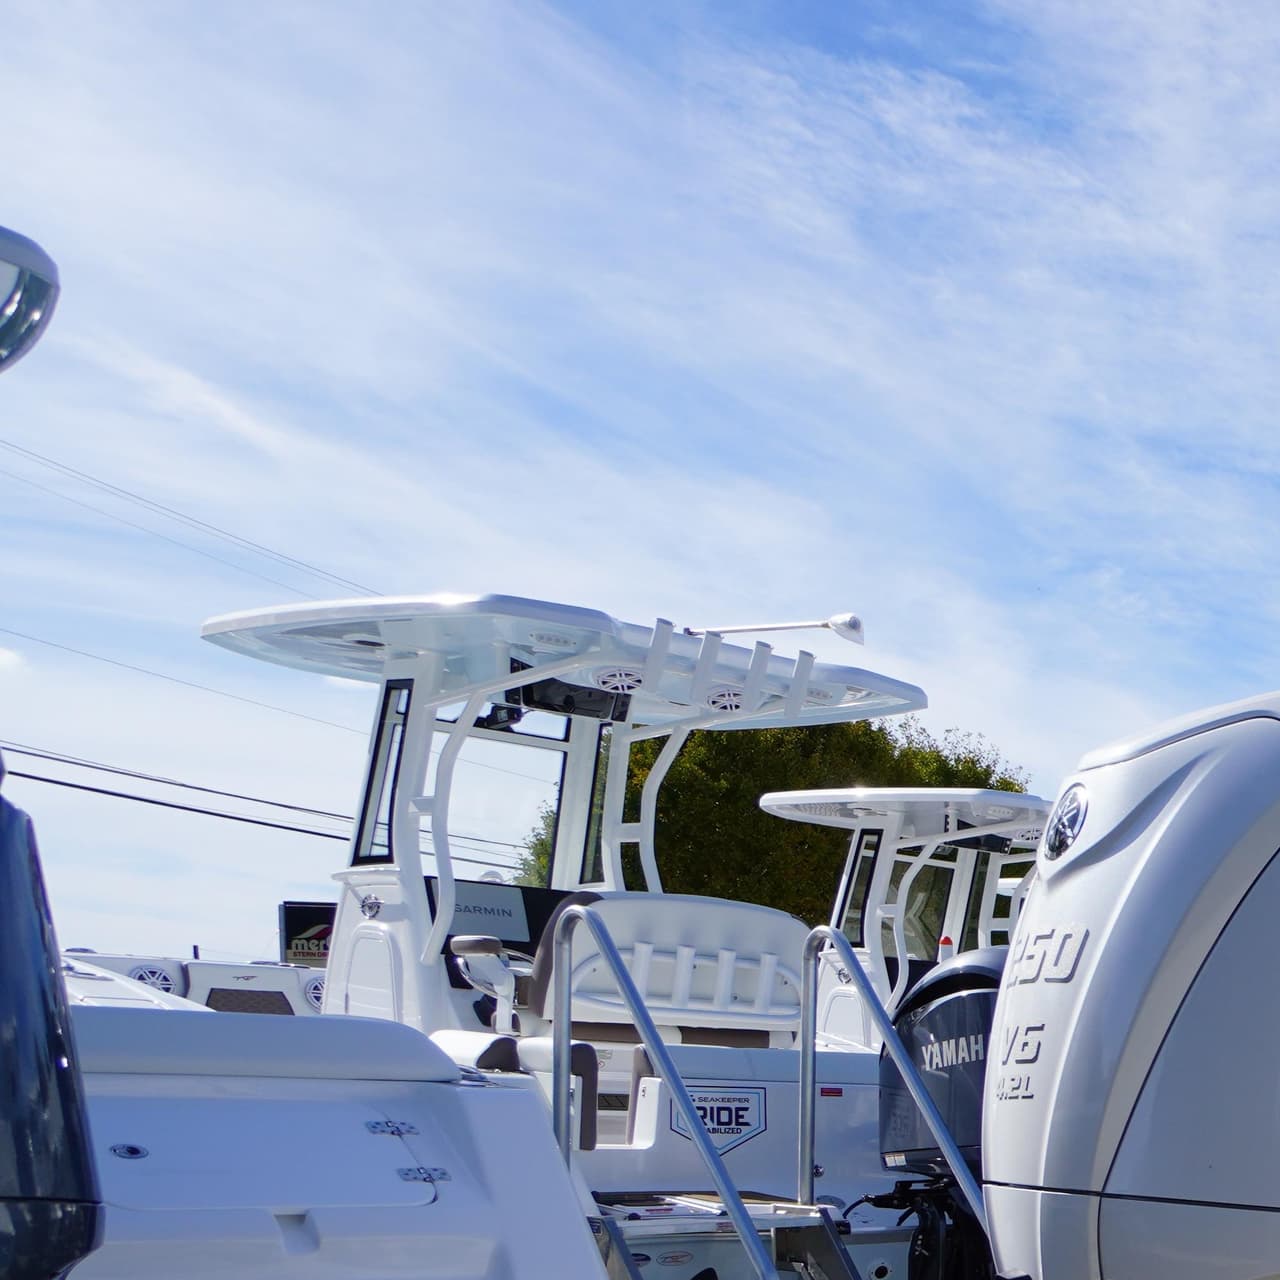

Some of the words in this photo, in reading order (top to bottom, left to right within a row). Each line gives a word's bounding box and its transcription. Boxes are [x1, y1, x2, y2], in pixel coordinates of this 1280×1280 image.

[922, 1034, 984, 1071] YAMAH
[1002, 1023, 1045, 1065] V6
[706, 1127, 742, 1135] ABILIZED
